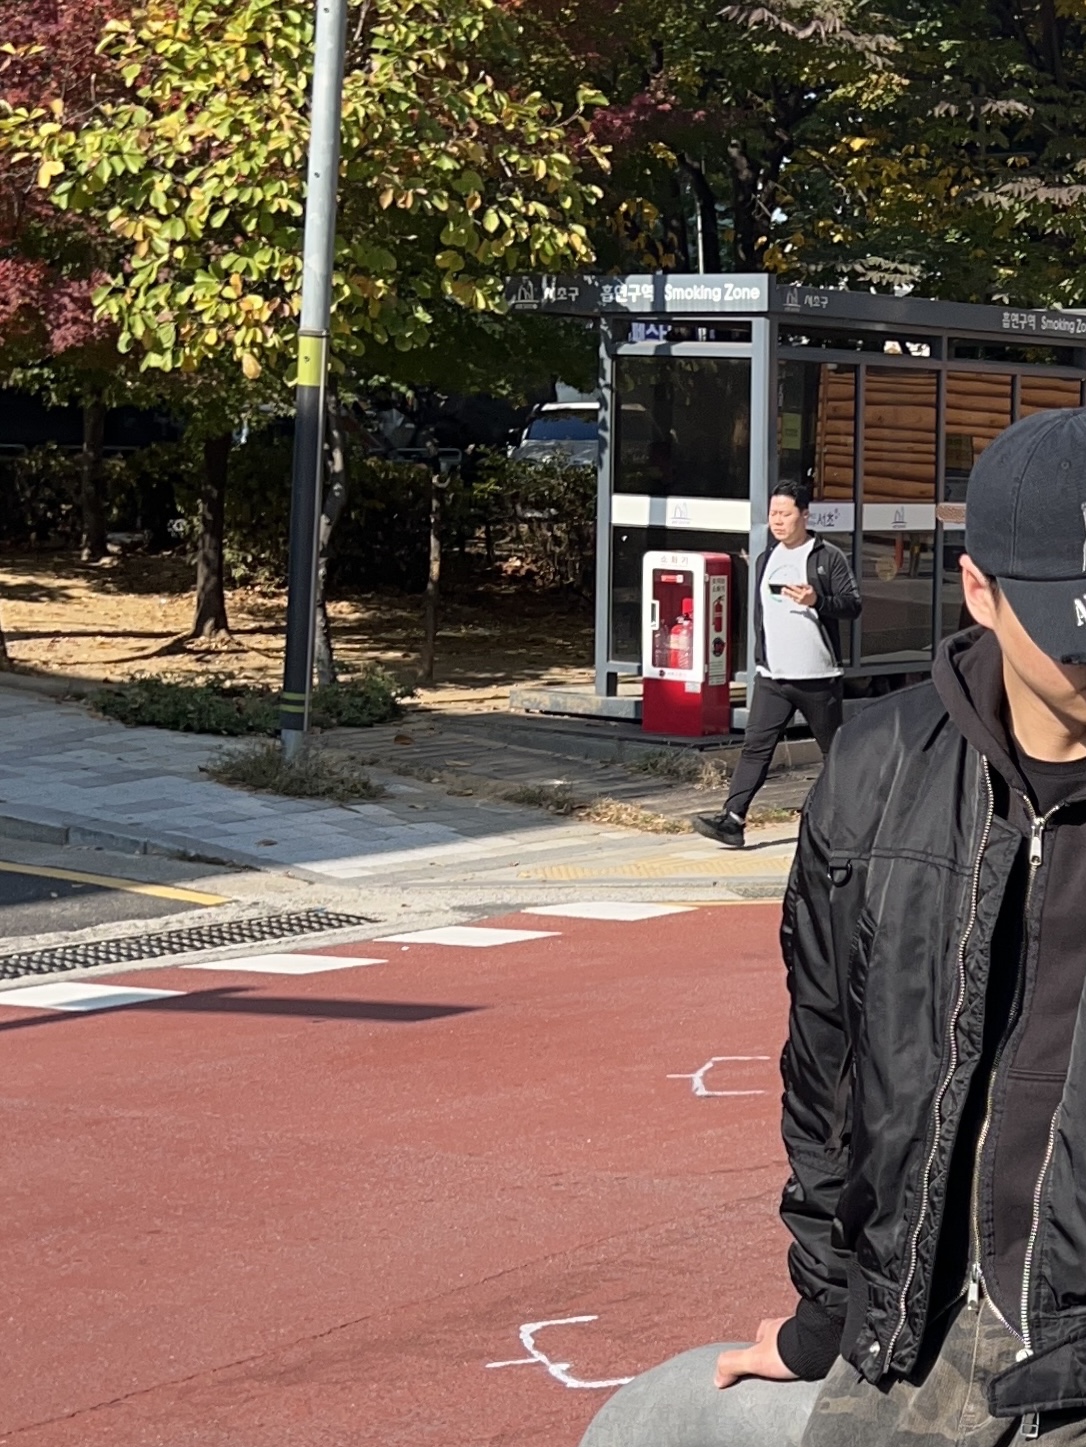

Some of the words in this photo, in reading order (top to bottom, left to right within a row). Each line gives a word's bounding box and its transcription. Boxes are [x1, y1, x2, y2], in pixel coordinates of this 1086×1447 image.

[600, 284, 654, 303] 흡연구역
[664, 283, 722, 302] Smoking
[723, 283, 761, 301] Zone
[804, 294, 829, 308] 서초구
[1002, 311, 1036, 331] 흡연구역
[1040, 315, 1075, 334] Smoking
